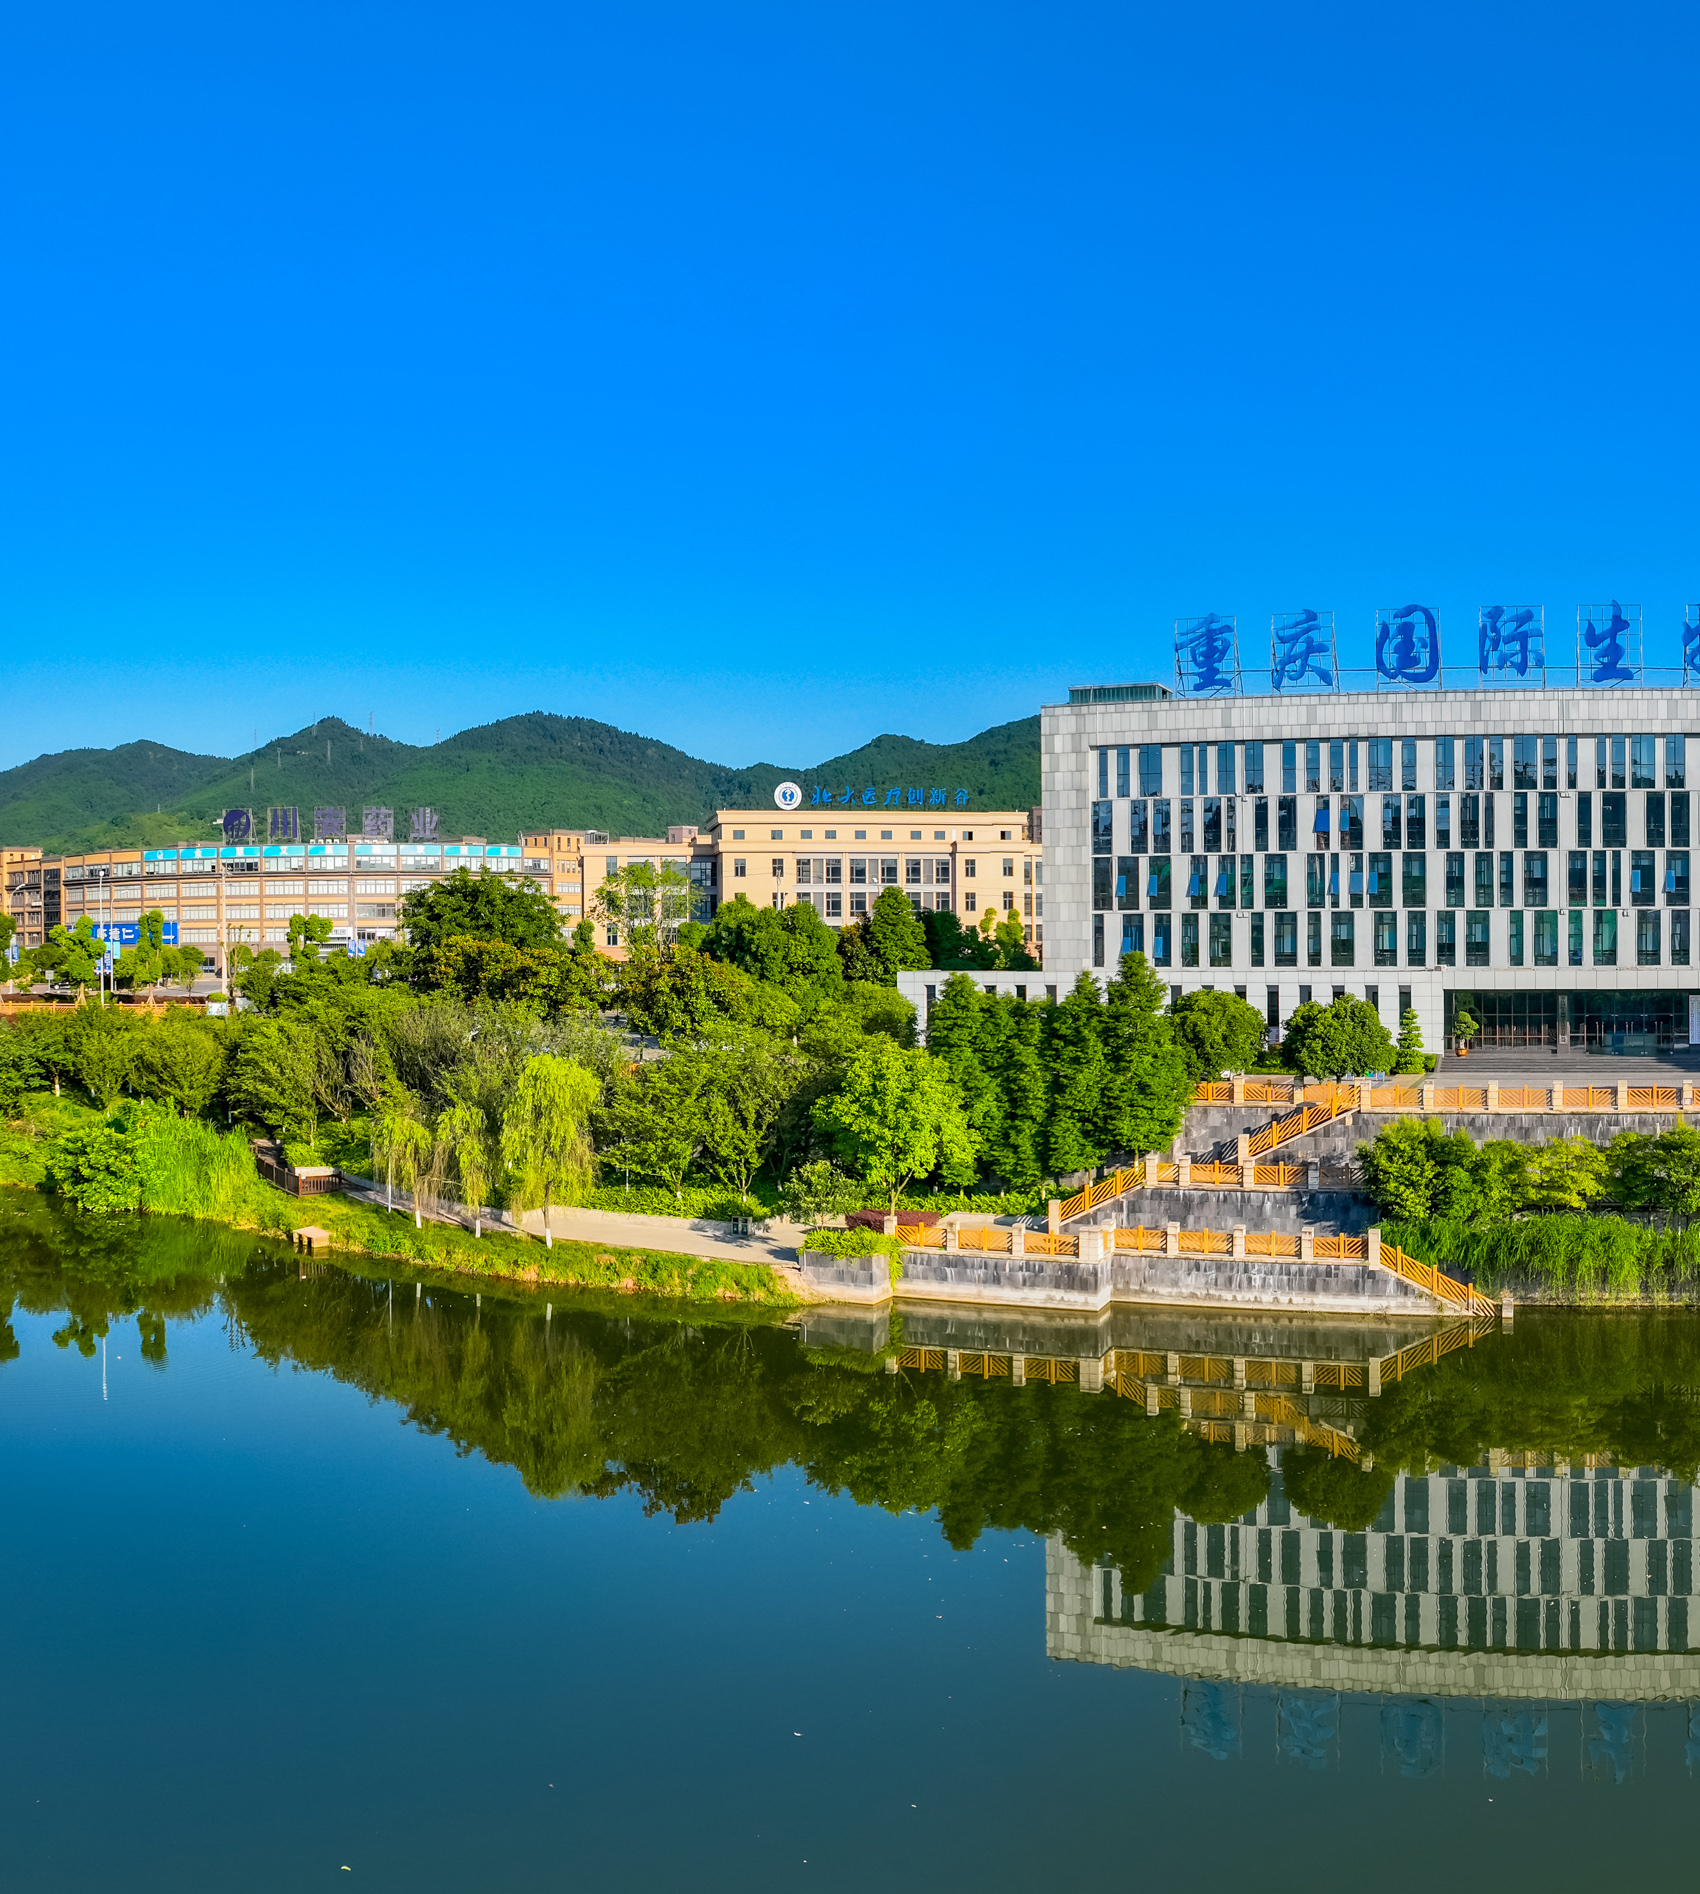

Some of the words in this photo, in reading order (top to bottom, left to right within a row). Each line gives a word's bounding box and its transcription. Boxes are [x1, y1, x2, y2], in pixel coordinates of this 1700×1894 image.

[811, 786, 969, 806] 北大医疗创新谷
[270, 806, 439, 838] 川安药业
